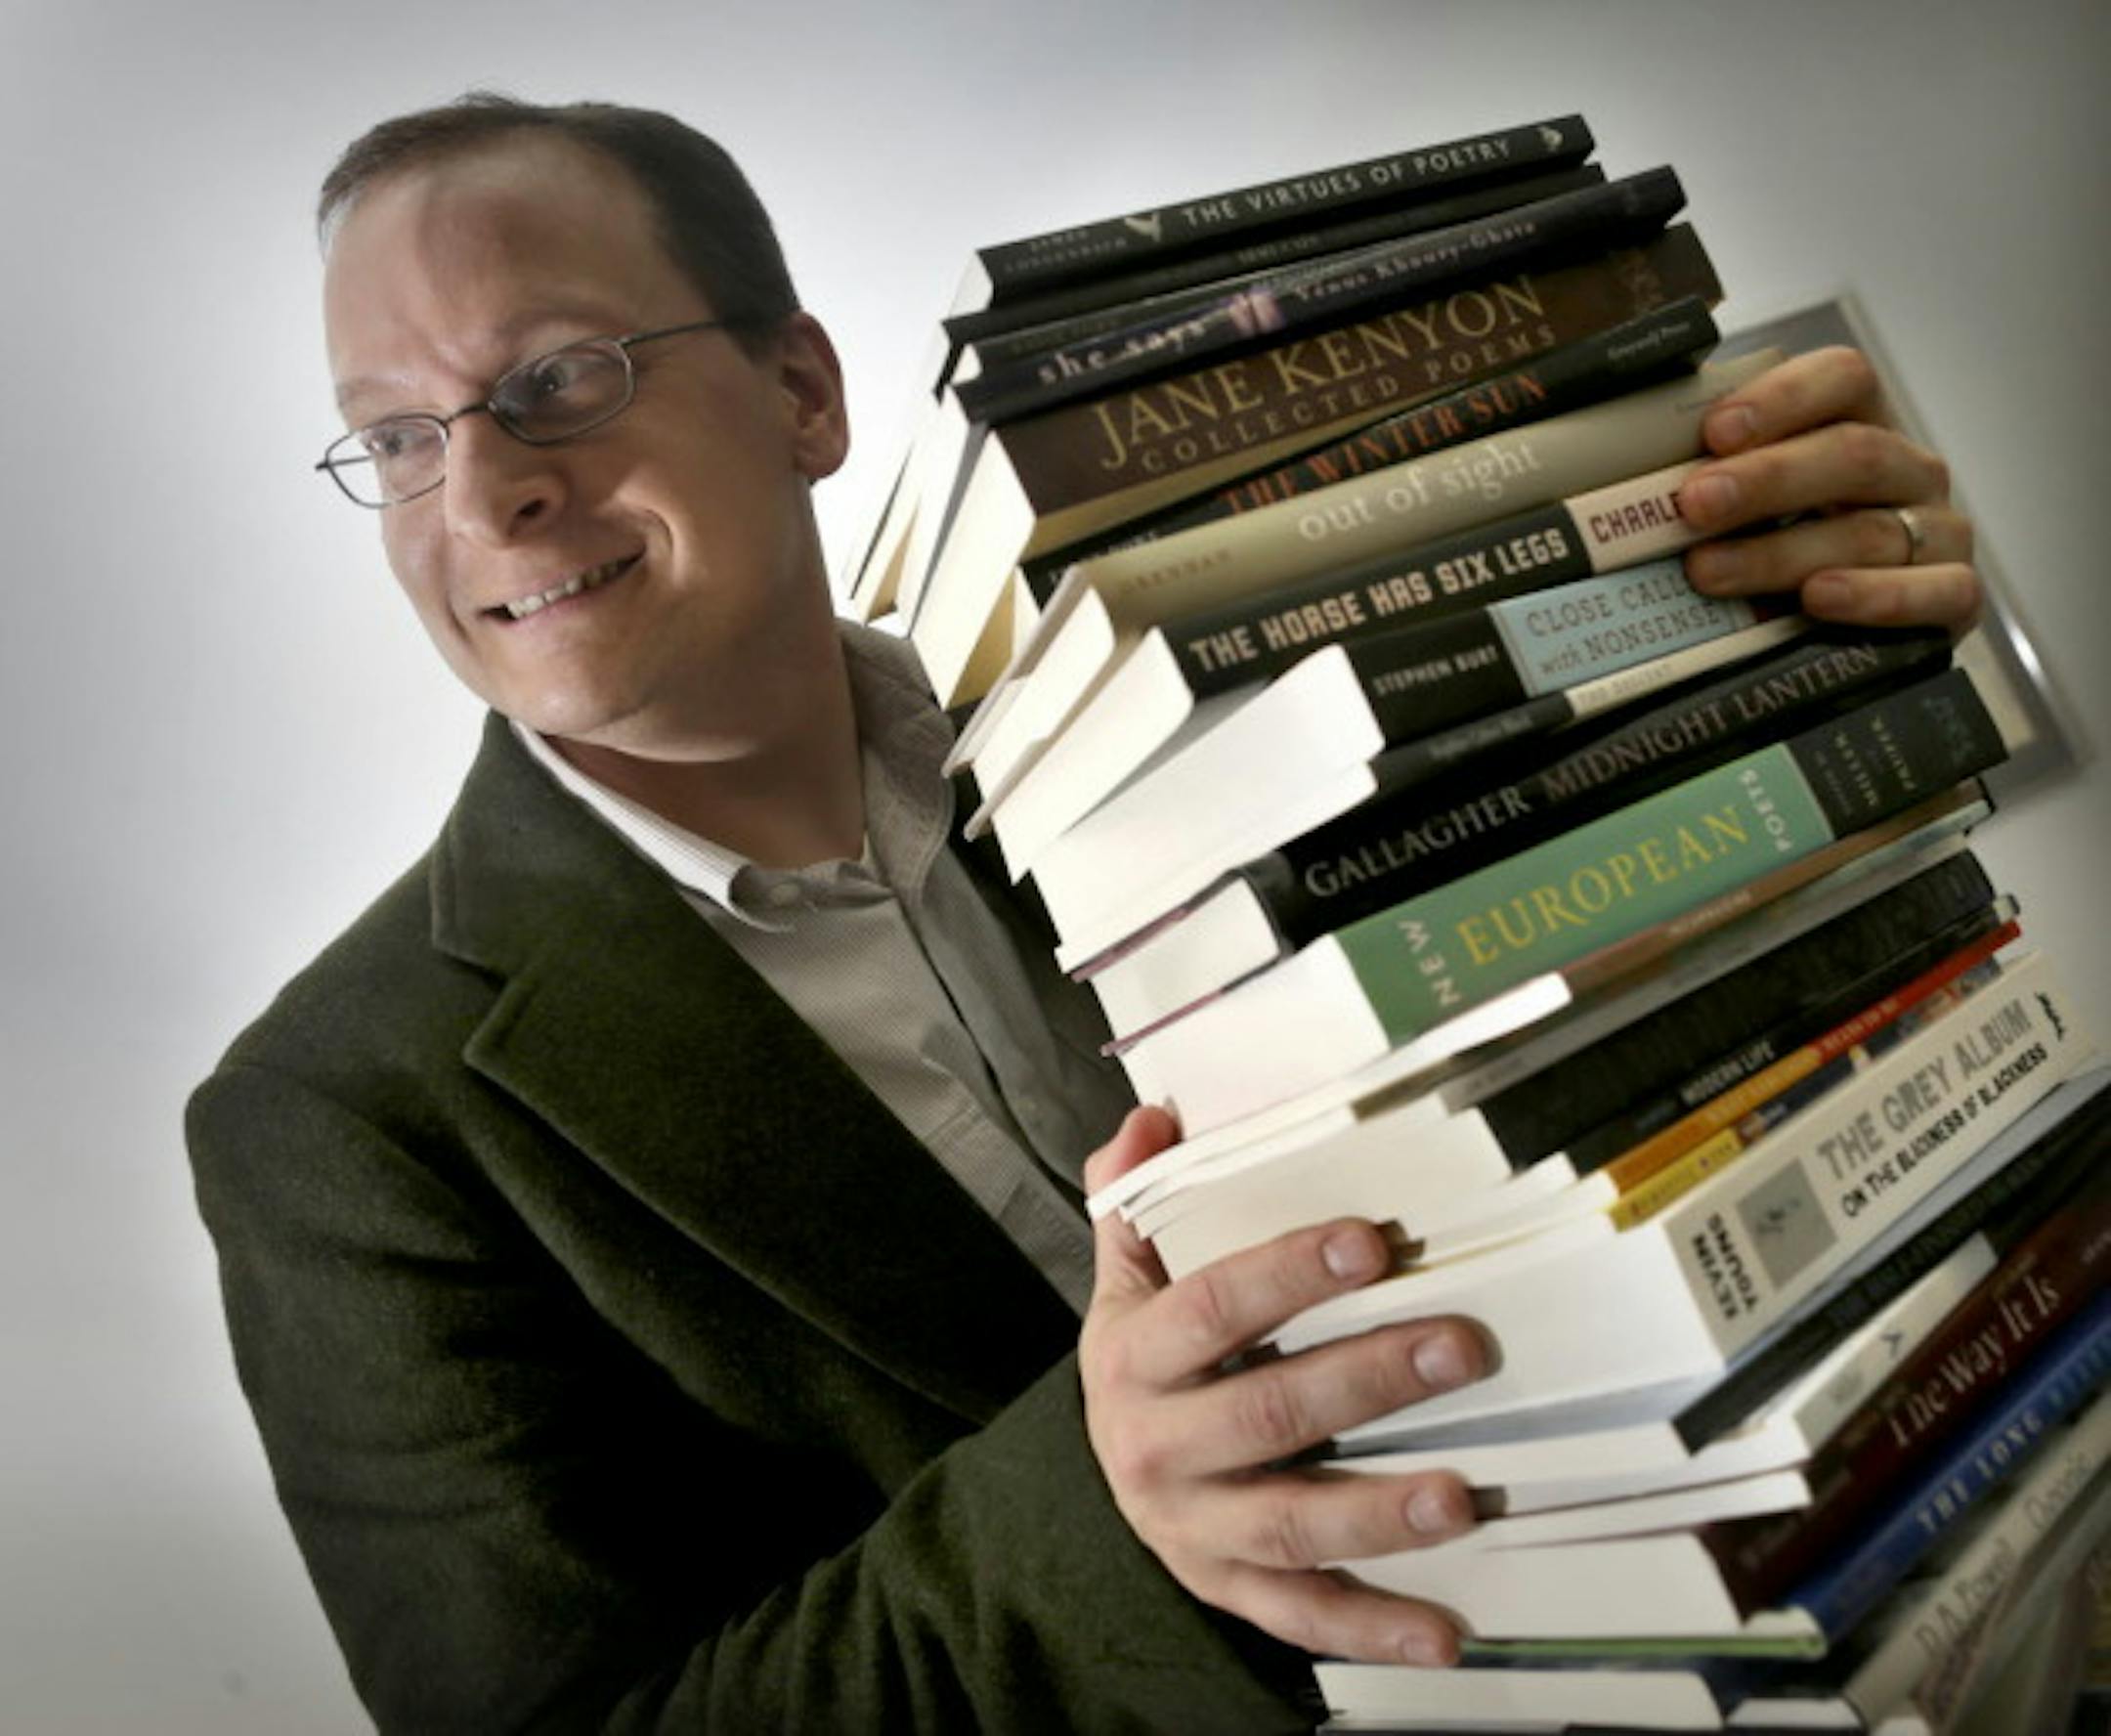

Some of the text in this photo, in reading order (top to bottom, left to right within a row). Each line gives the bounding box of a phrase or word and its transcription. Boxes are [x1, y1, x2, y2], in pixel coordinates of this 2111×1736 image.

[1183, 138, 1512, 228] THE VIRTUES OF POETRY
[1037, 348, 1107, 385] she
[1094, 275, 1546, 469] JANE KENYON
[1142, 375, 1399, 471] COLLECTED
[1427, 325, 1557, 384] POEMS
[1217, 371, 1548, 514] THE WINTER SUN
[1298, 440, 1541, 542] out of sight
[1188, 624, 1259, 673] THE
[1262, 591, 1366, 652] HORSE
[1368, 571, 1435, 618] HAS
[1436, 554, 1495, 593] SIX
[1495, 527, 1569, 576] LEGS
[1527, 592, 1614, 638] CLOSE
[1540, 602, 1721, 676] with NONSENSE
[1373, 645, 1499, 696] STEPHEN BURT
[1305, 785, 1532, 898] GALLAGHER
[1543, 702, 1730, 802] MIDNIGHT
[1734, 640, 1879, 720] LANTERN
[1739, 768, 1792, 852] POETS
[1454, 804, 1749, 967] EUROPEAN
[1399, 918, 1461, 1007] NEW
[1816, 1112, 1885, 1181] THE
[1882, 1055, 1957, 1132] GREY
[1956, 998, 2033, 1078] ALBUM
[1841, 1045, 2049, 1218] ON THE BLACKNESS OF BLACKNESS
[1706, 1212, 1757, 1312] YOUNG
[1887, 1380, 1949, 1449] The
[1940, 1324, 2007, 1396] Way
[1999, 1297, 2034, 1343] It
[2022, 1274, 2061, 1318] Is
